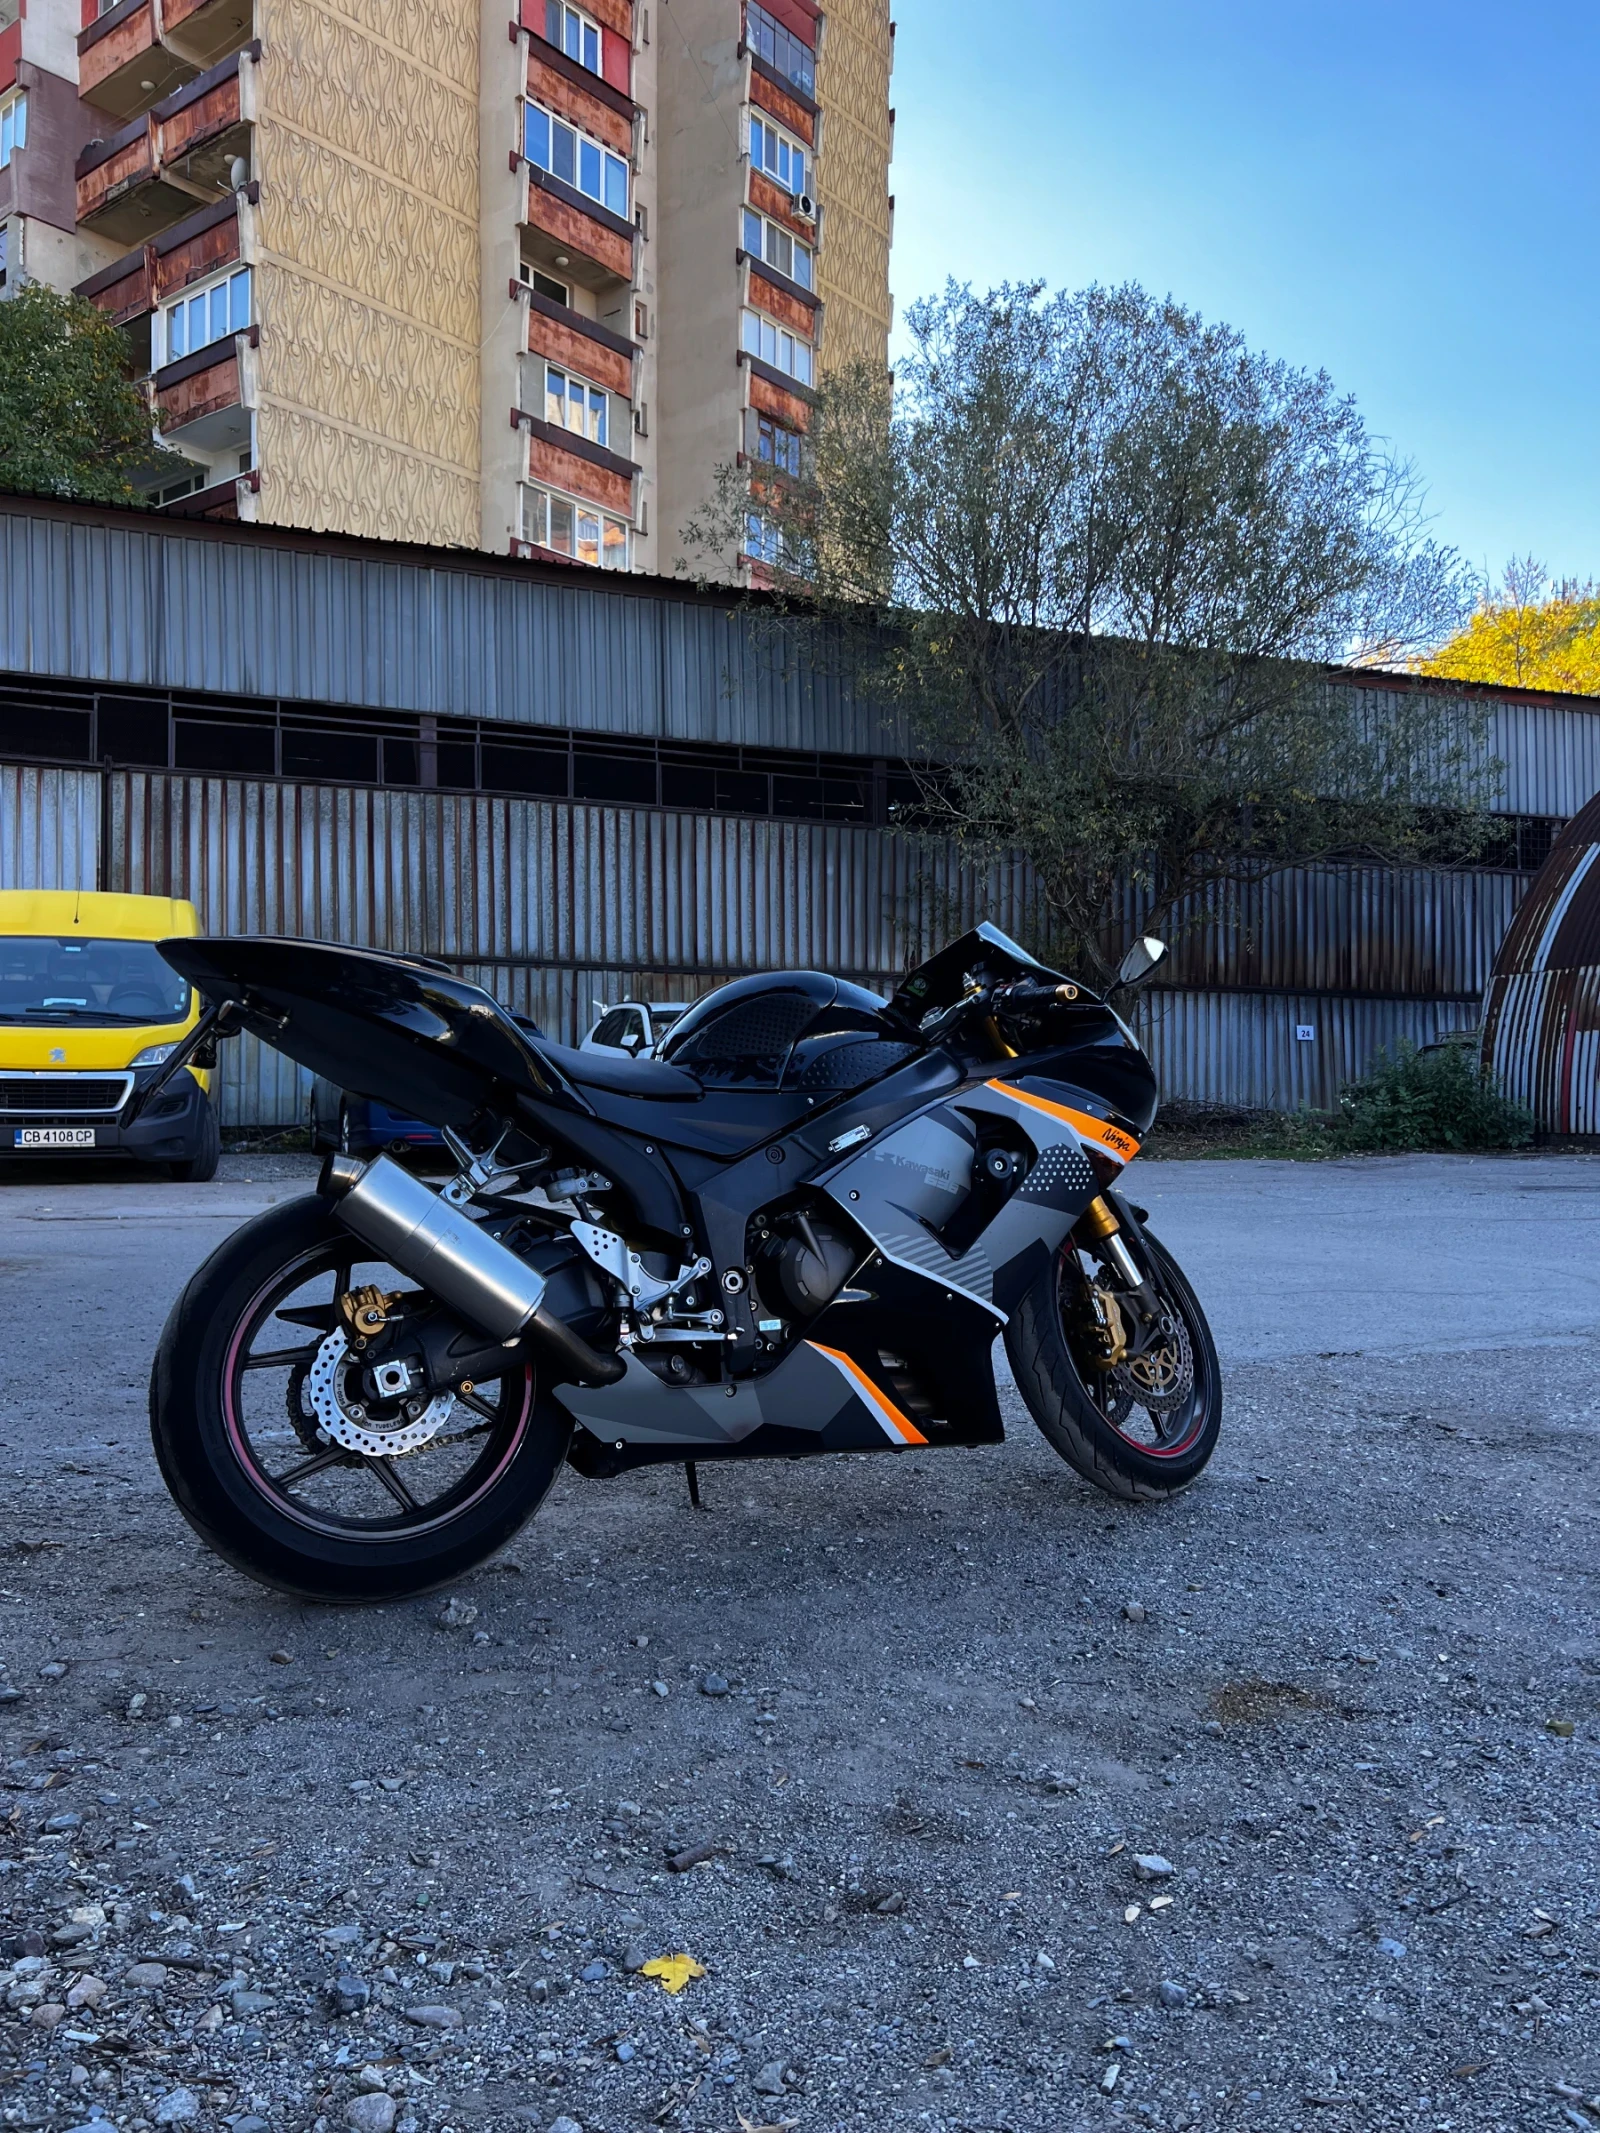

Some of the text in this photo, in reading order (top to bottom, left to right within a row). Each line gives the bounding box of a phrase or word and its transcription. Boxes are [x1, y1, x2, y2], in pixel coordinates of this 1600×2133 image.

[1301, 1030, 1310, 1038] 24
[24, 1131, 41, 1142] CB
[43, 1131, 74, 1142] 4108
[75, 1130, 93, 1142] CP
[1101, 1127, 1130, 1152] Ninja
[895, 1155, 951, 1181] Kawasaki
